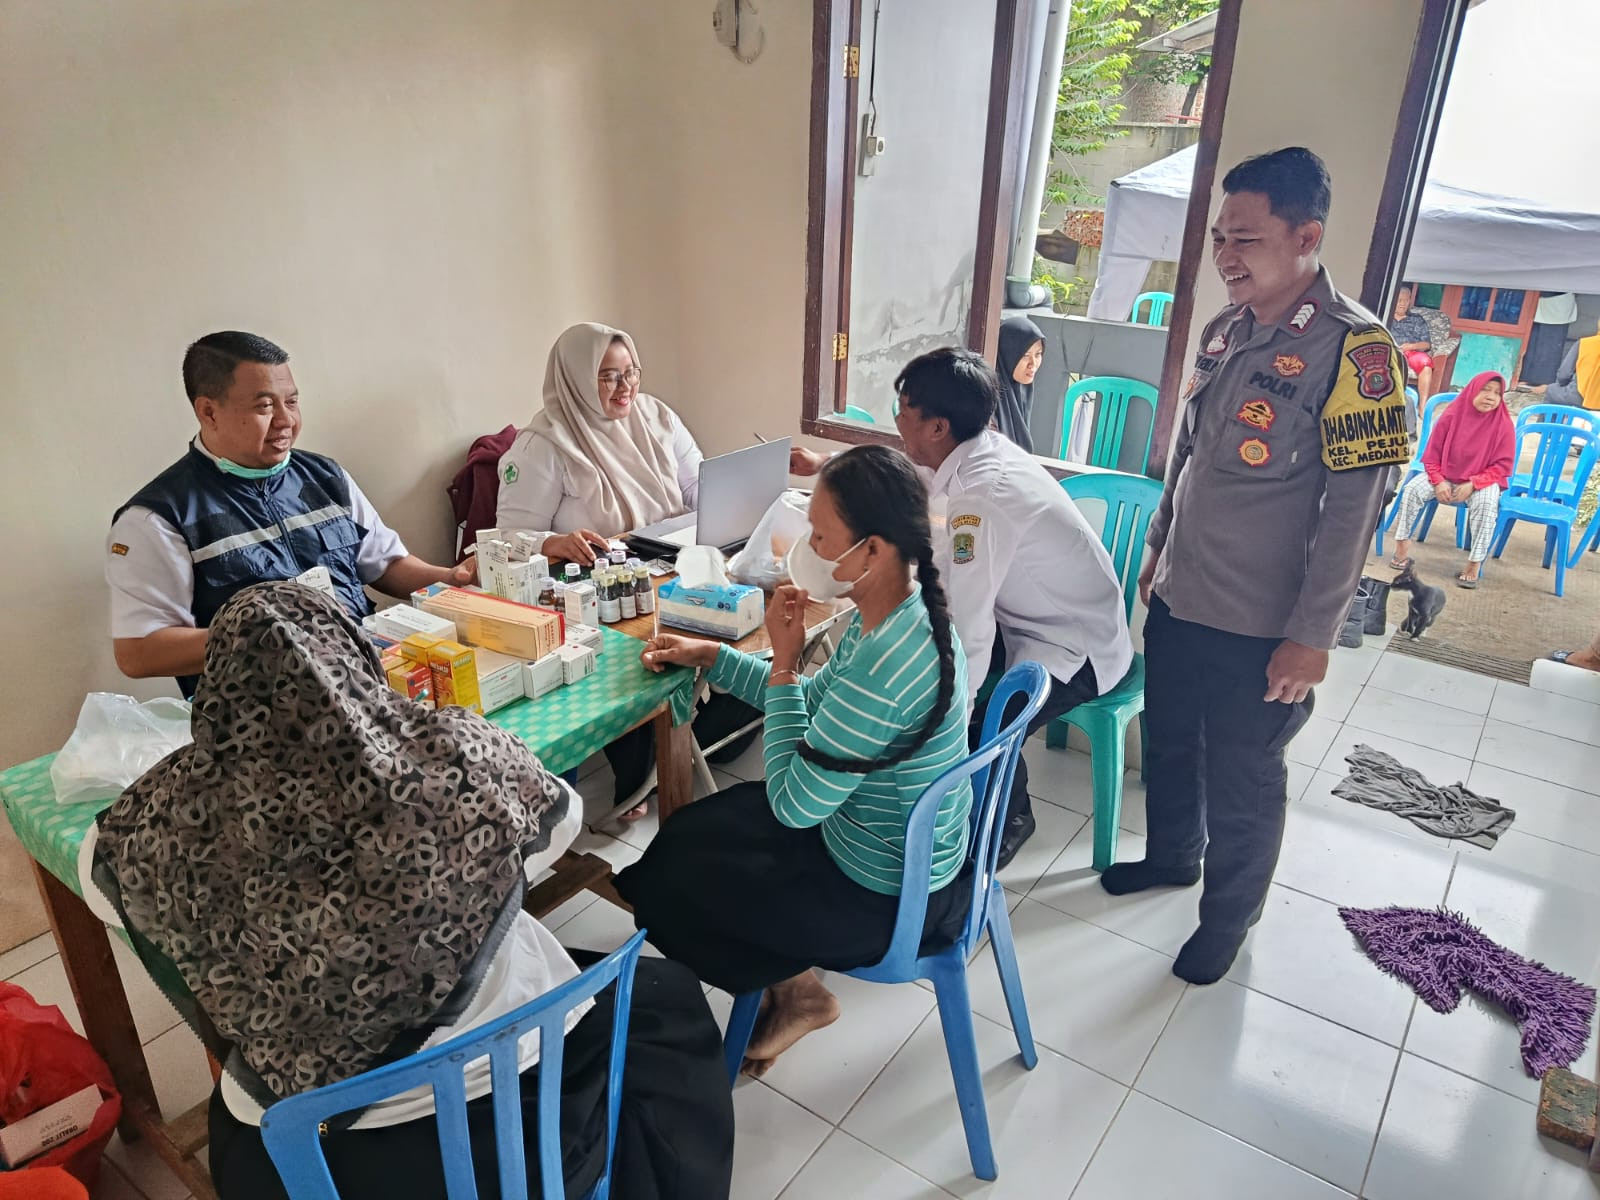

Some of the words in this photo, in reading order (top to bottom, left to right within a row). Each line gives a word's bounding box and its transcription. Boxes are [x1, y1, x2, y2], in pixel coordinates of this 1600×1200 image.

[1249, 371, 1297, 400] POLRI
[1328, 446, 1358, 458] KEL.
[1331, 456, 1353, 467] KEC.
[1357, 448, 1399, 463] MEDAN
